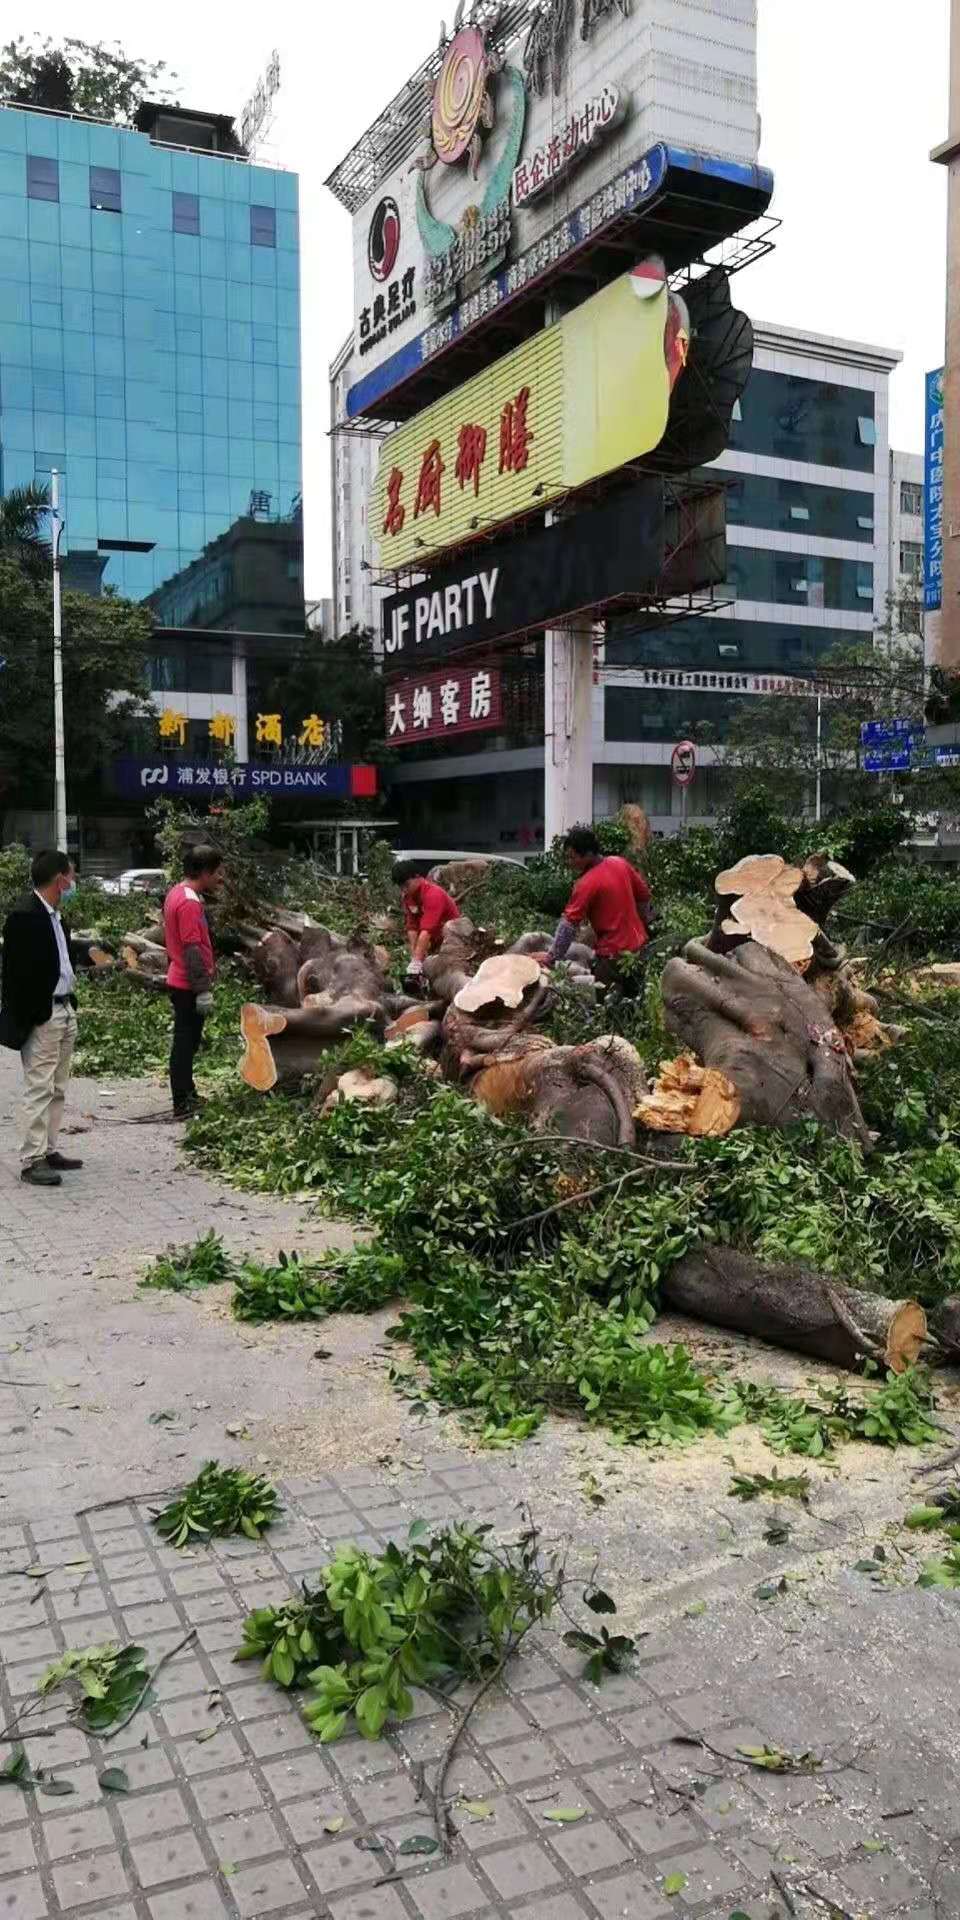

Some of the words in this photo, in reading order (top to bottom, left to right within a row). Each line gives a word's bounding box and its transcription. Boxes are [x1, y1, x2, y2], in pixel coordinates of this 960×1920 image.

[513, 86, 618, 204] 民企活动中心
[359, 266, 416, 338] 古典足疗
[383, 386, 533, 537] 名厨御膳
[385, 603, 411, 655] JF
[414, 567, 499, 643] PARTY
[158, 708, 326, 747] 新都酒店
[389, 670, 492, 736] 大绅客房
[177, 767, 247, 785] 浦发银行
[251, 770, 281, 786] SPD
[284, 771, 328, 787] BANK
